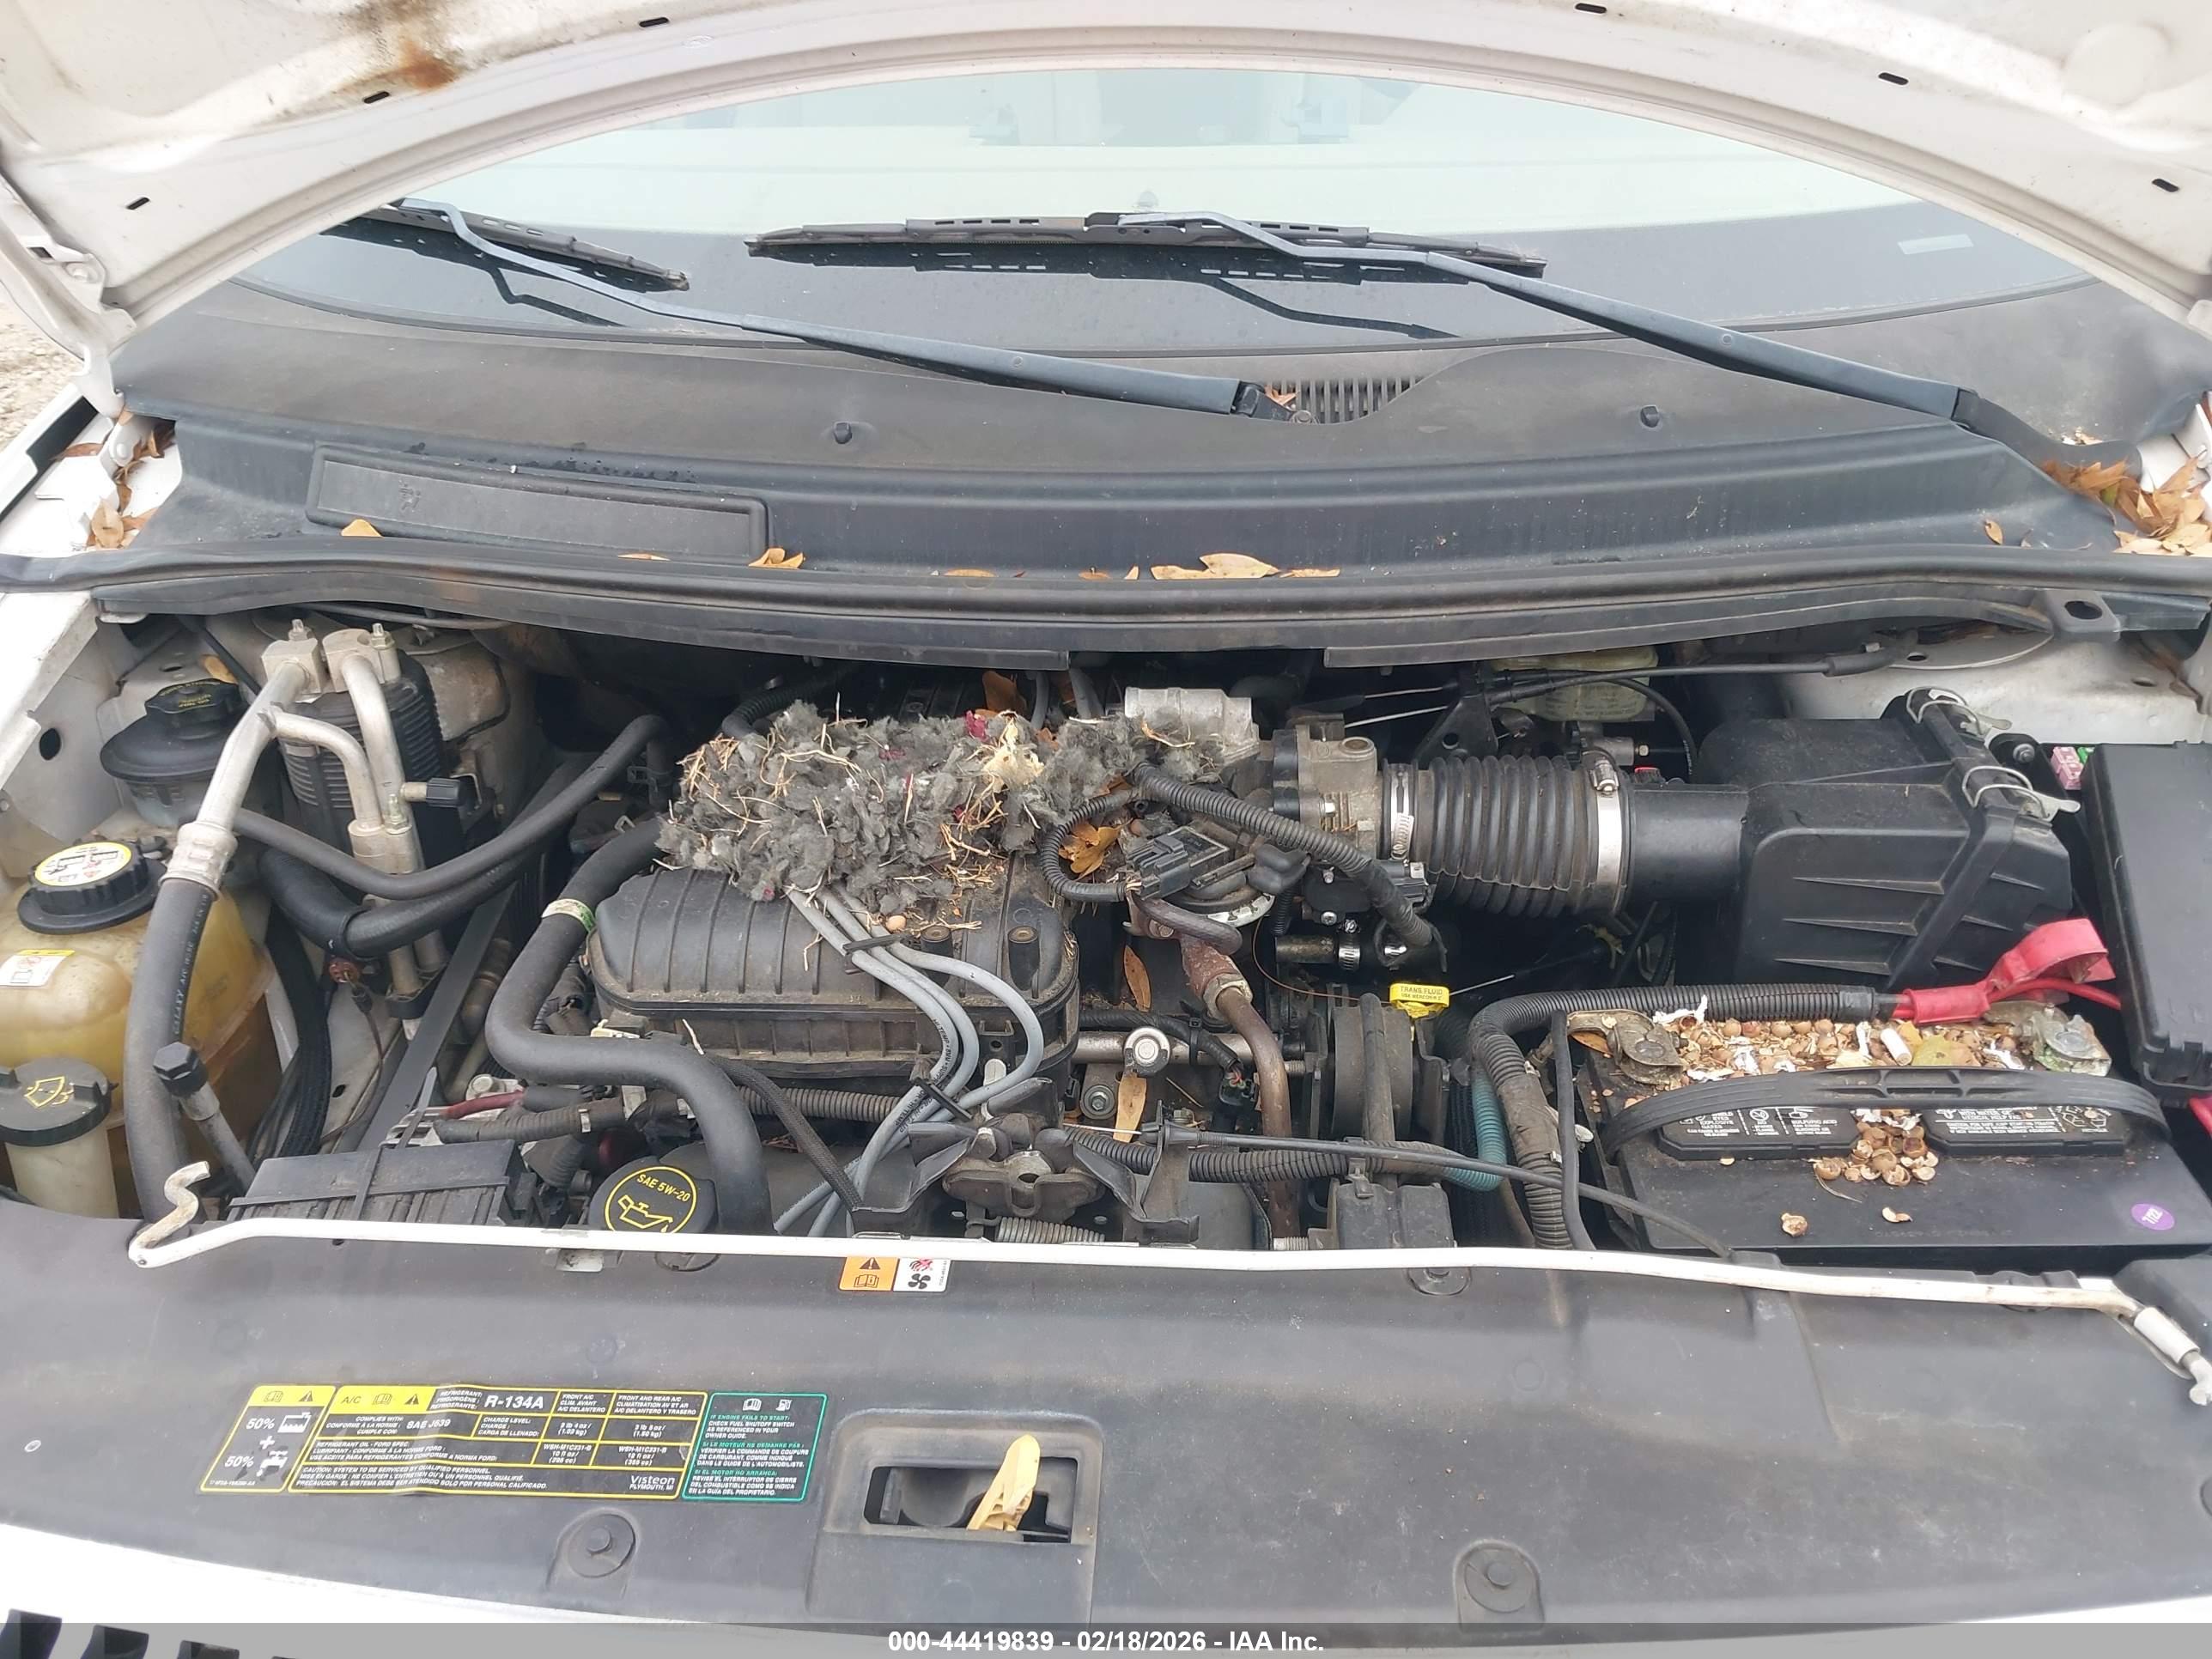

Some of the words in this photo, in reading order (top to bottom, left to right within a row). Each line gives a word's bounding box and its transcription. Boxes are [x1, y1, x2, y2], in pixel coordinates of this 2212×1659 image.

[637, 1174, 659, 1188] SAE
[657, 1182, 691, 1202] 5W-20
[484, 1395, 544, 1409] R-134A
[246, 1418, 275, 1430] 50%
[406, 1420, 427, 1430] SAE
[428, 1419, 451, 1428] J639
[225, 1455, 254, 1468] 50%
[631, 1475, 676, 1485] Visteon
